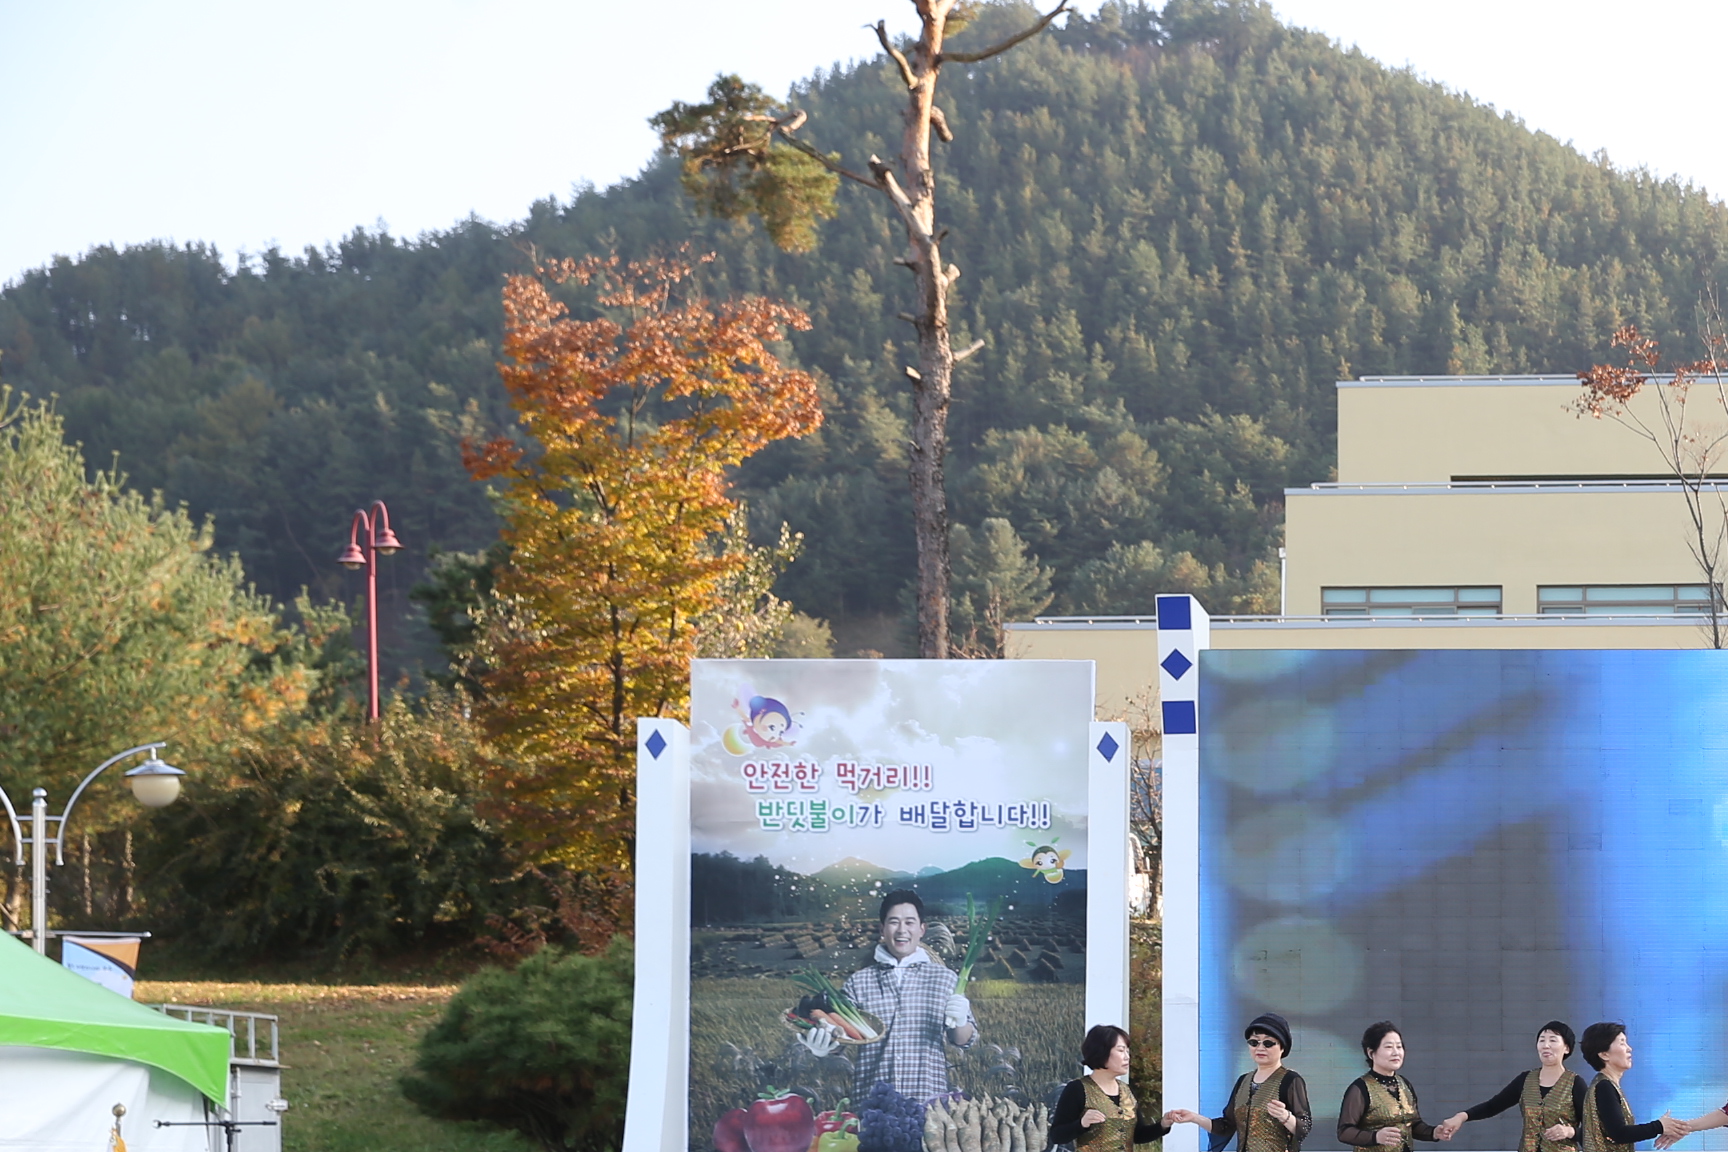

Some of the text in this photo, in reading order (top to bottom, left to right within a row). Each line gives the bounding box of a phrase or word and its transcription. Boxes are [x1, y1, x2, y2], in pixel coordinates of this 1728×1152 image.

[743, 761, 931, 792] 안전한 먹거리!!
[758, 799, 1050, 830] 반딧불이가 배달합니다!!
